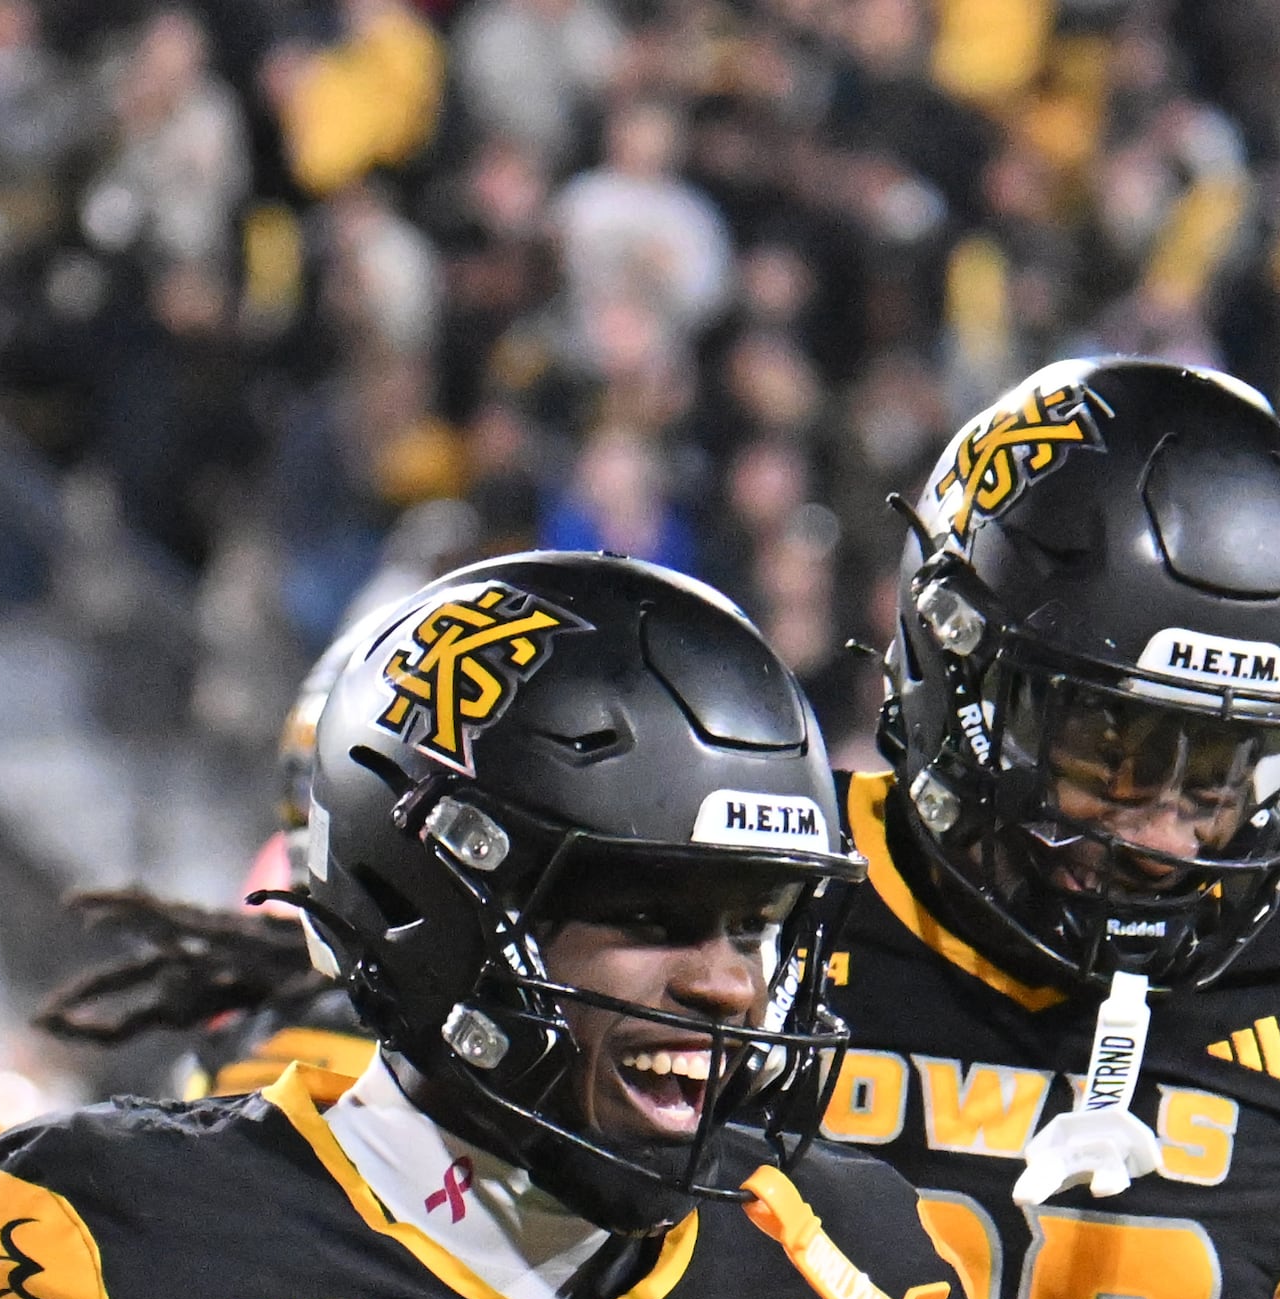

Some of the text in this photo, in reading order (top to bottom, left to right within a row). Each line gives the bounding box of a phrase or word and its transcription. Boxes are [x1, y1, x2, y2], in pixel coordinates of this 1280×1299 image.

[1169, 641, 1279, 682] H.E.T.M.
[726, 801, 820, 836] H.E.T.M.
[1107, 918, 1166, 937] Riddell
[818, 1048, 1239, 1187] OWS
